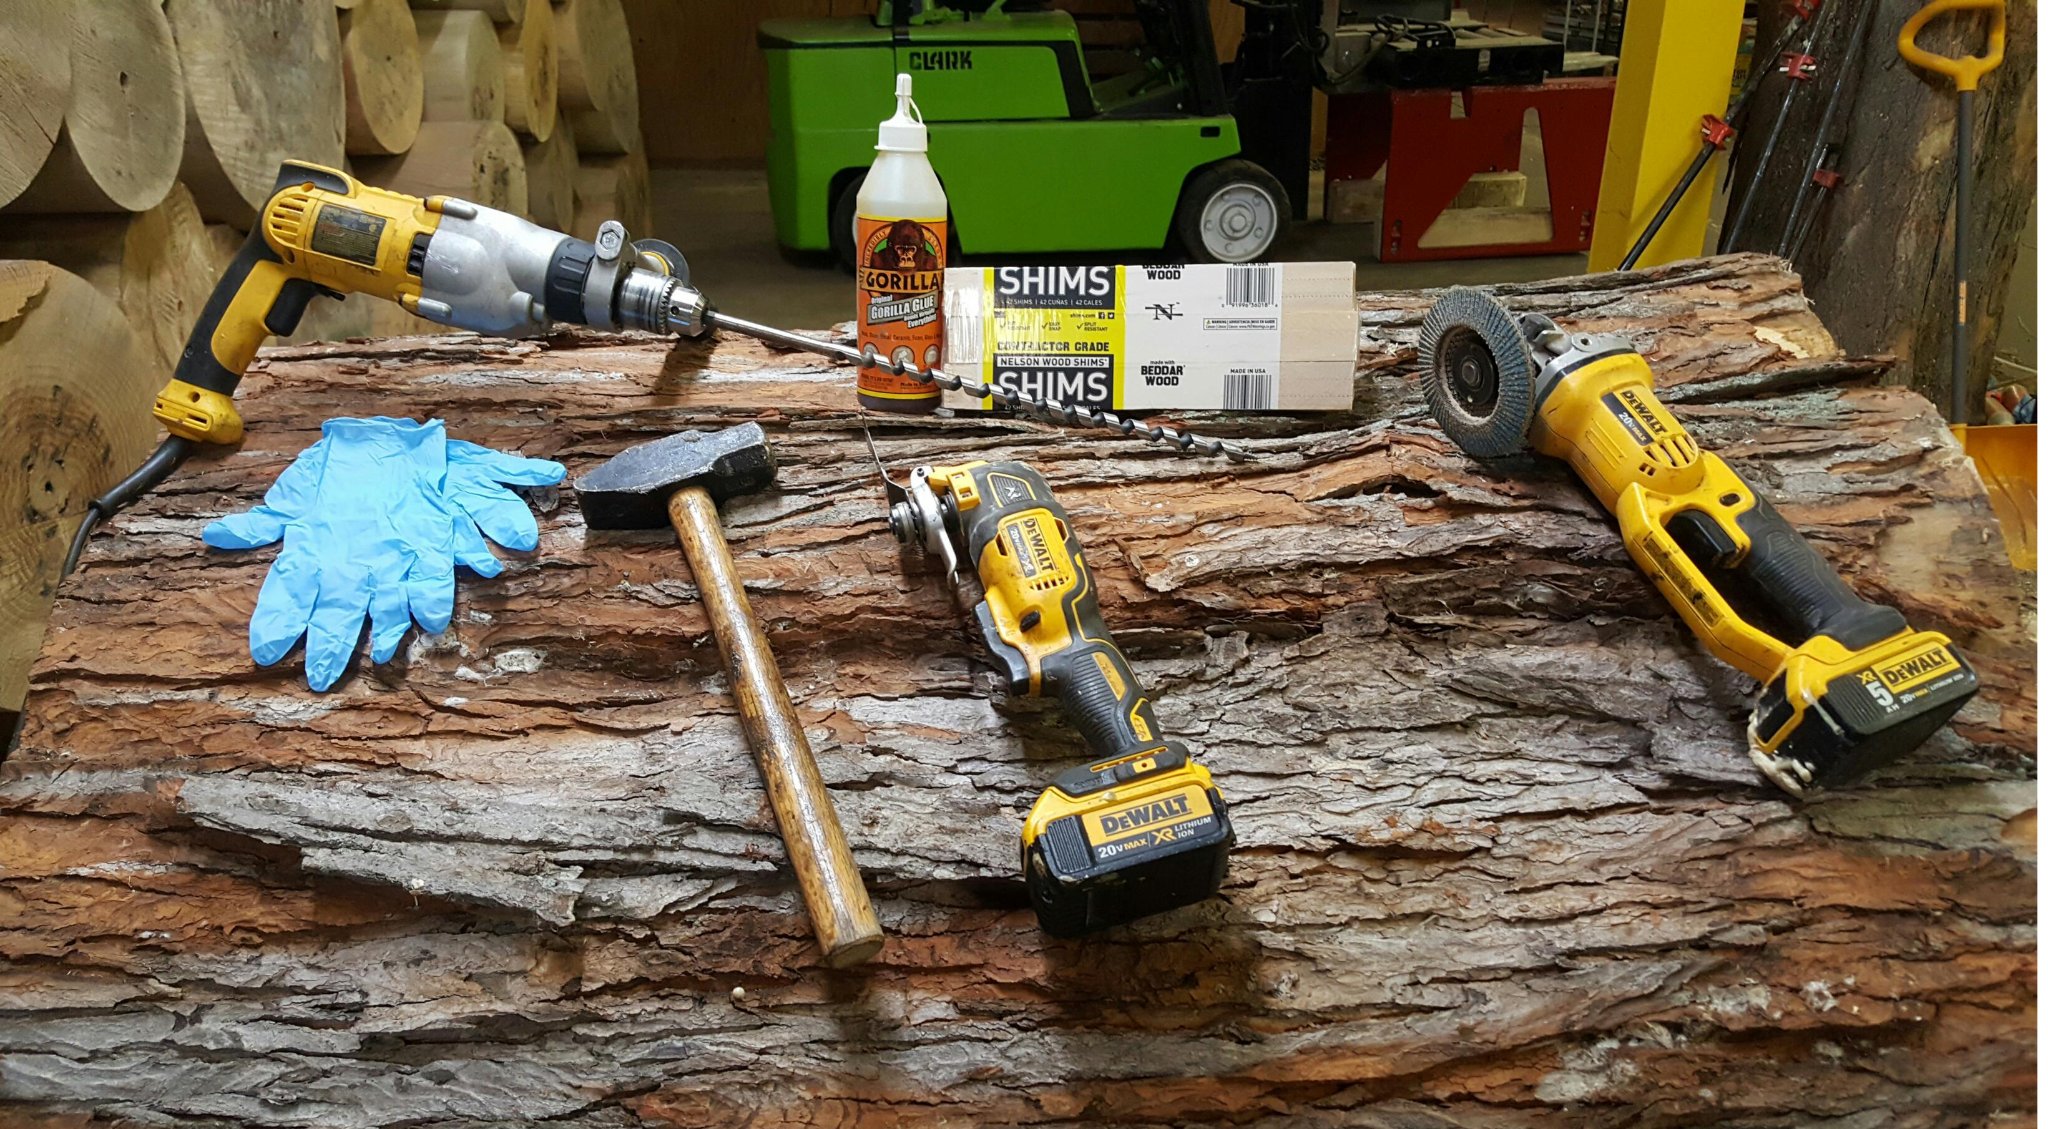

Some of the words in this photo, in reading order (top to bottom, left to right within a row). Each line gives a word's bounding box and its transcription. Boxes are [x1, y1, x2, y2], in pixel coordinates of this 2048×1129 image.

[909, 51, 972, 70] CLARK
[866, 272, 940, 290] GORILLA
[999, 266, 1110, 296] SHIMS
[1147, 270, 1181, 280] WOOD
[871, 302, 910, 320] GORILLA
[912, 295, 934, 312] GLUE
[1048, 298, 1068, 306] CUÑAS
[997, 341, 1070, 352] CONTRACTOR
[1074, 341, 1110, 352] GRADE
[1000, 357, 1040, 367] NELSON
[1042, 357, 1071, 367] WOOD
[998, 371, 1108, 402] SHIMS
[1145, 376, 1179, 386] WOOD
[1865, 681, 1894, 707] 5
[1174, 816, 1212, 832] LITHIUM
[1151, 829, 1178, 845] XR
[1177, 829, 1195, 839] ION
